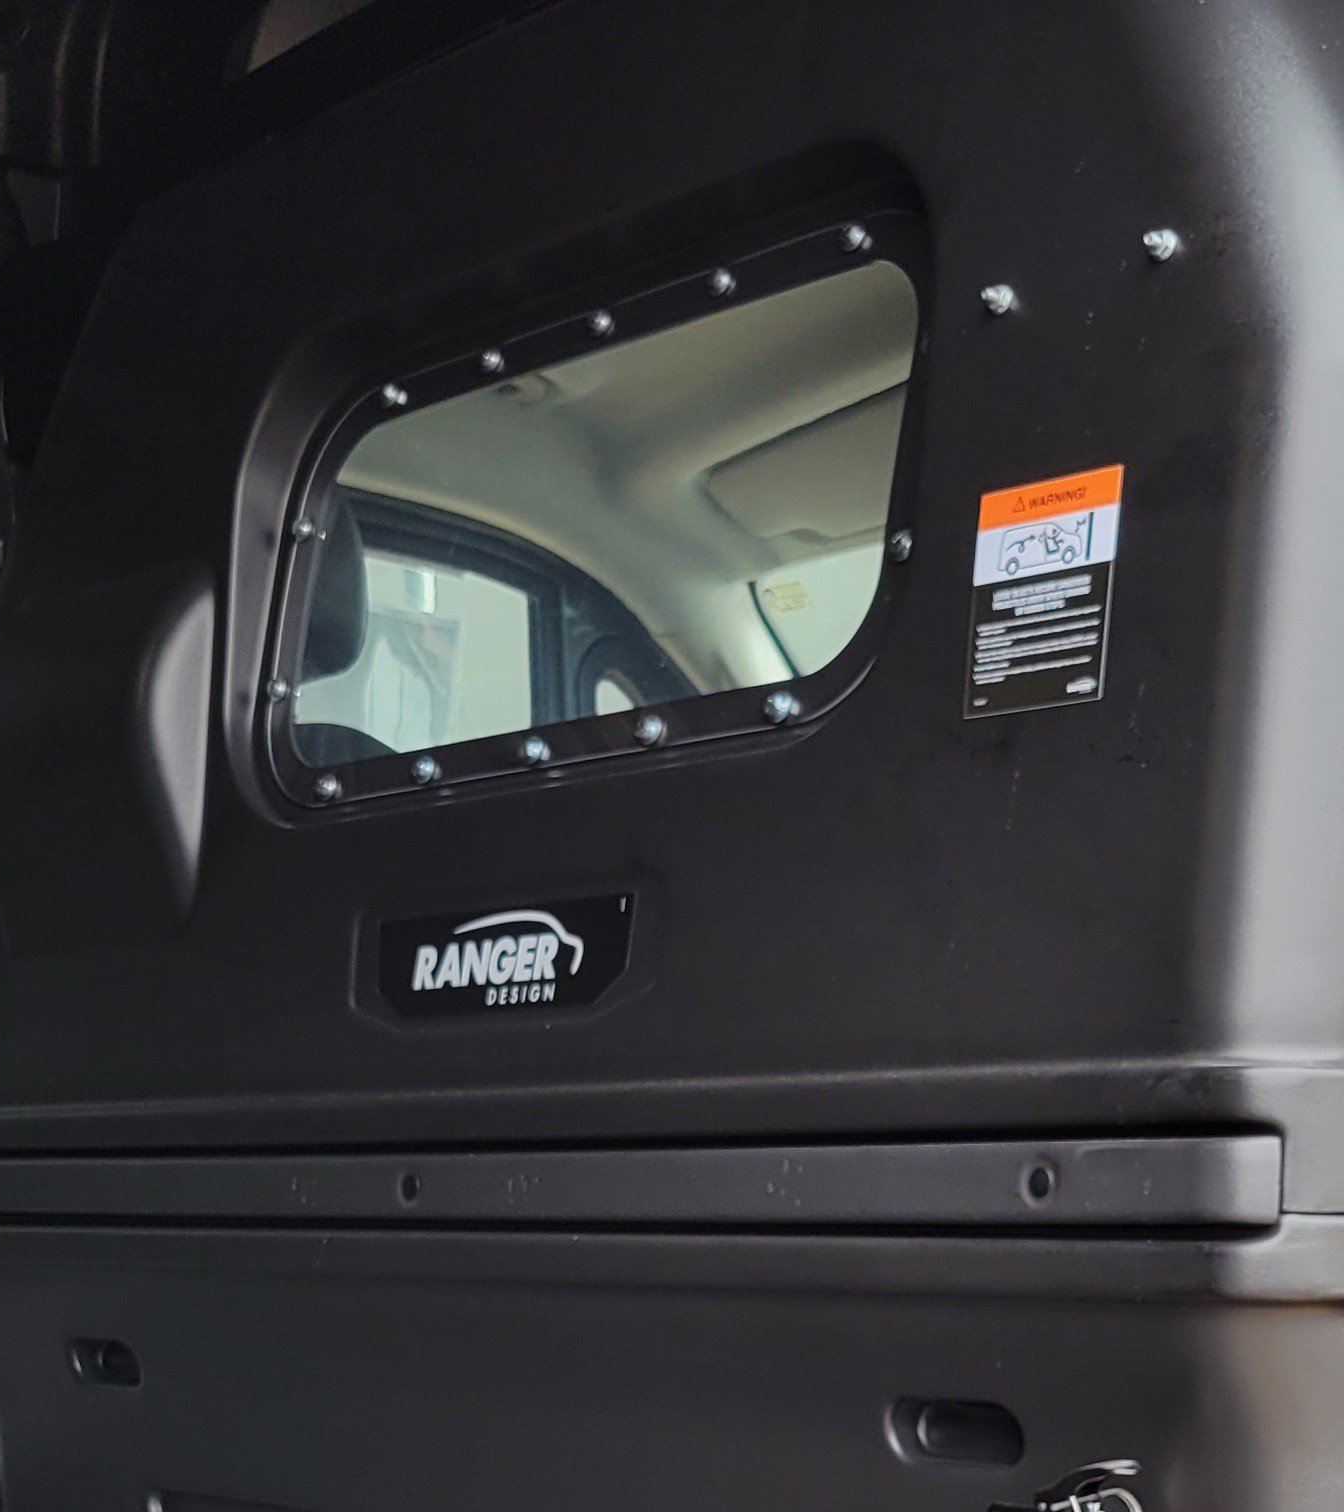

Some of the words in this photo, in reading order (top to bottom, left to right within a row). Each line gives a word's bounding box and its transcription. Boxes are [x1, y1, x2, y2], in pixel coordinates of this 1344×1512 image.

[1028, 487, 1087, 509] WARNING!
[412, 932, 560, 991] RANGER
[485, 983, 557, 1006] DESIGN
